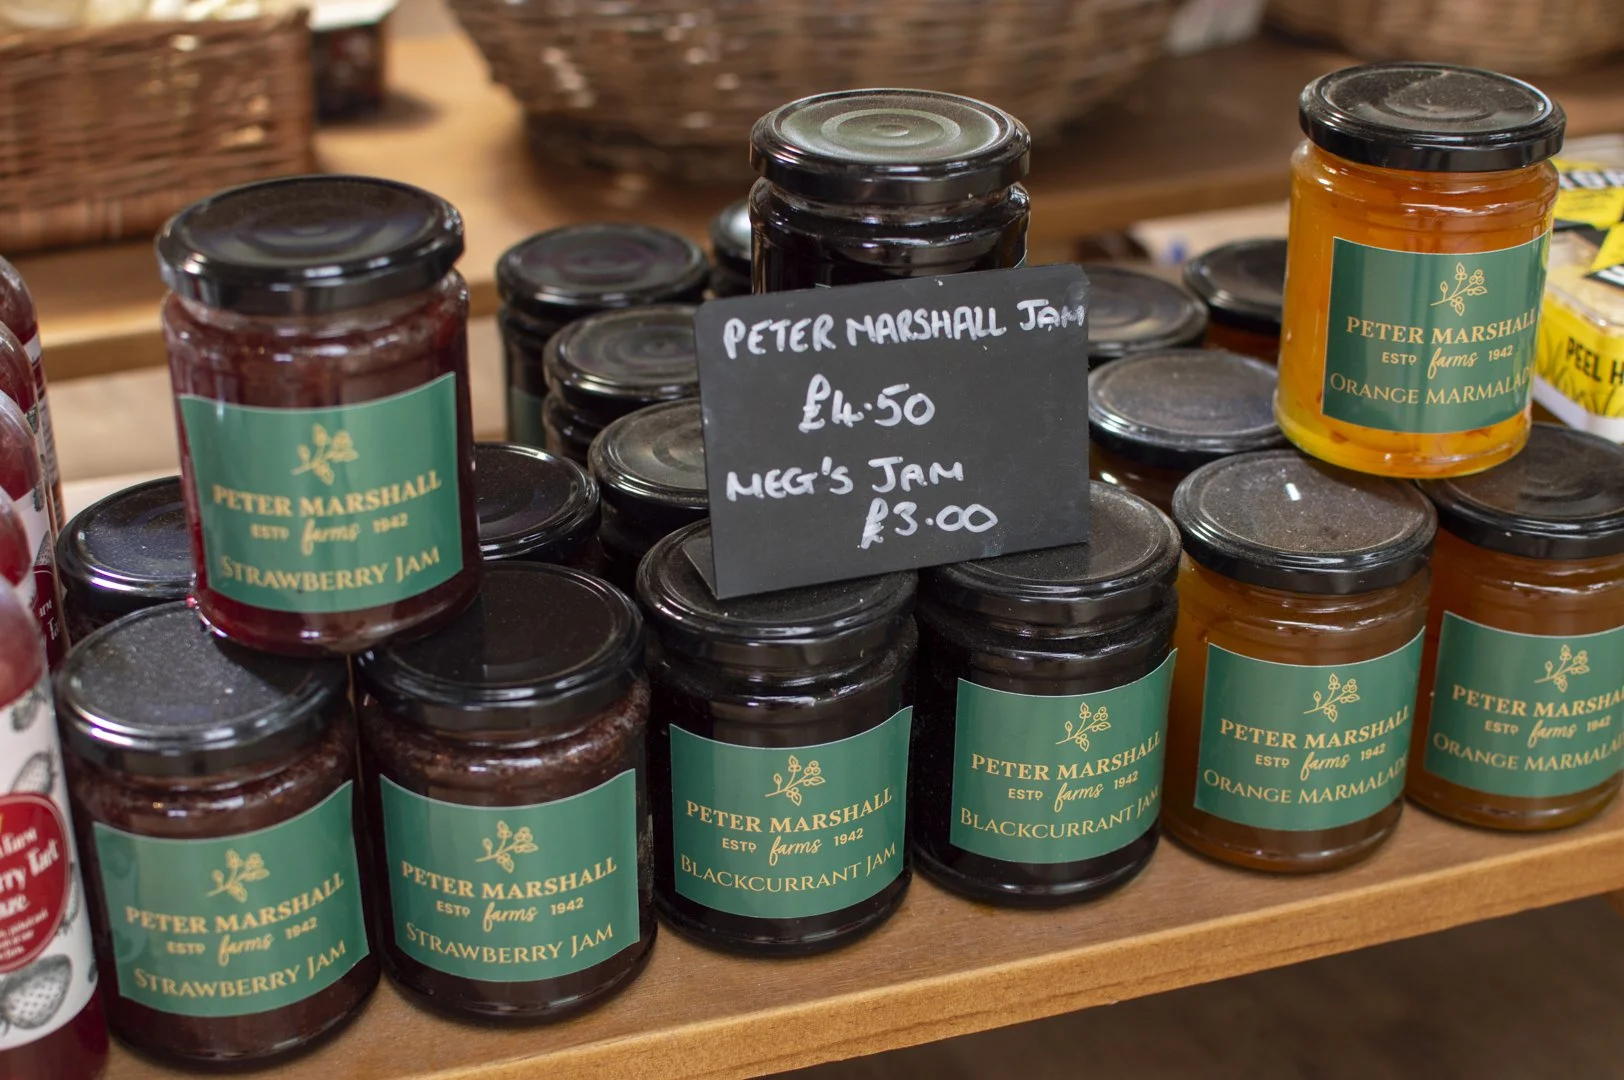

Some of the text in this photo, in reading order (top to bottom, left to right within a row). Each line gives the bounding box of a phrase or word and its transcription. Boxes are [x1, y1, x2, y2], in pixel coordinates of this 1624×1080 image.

[723, 299, 1085, 360] PETER MARSHALL JAM
[1346, 308, 1536, 344] PETER MARSHALL
[1381, 345, 1514, 380] ESTD farms 1942
[1566, 336, 1602, 383] PEEL
[799, 374, 935, 432] £4.50
[1330, 366, 1531, 405] ORANGE MARMALAD
[213, 470, 442, 518] PETER MARSHALL
[726, 456, 964, 501] MEG'S JAM
[252, 513, 408, 557] ESTD farms 1942
[860, 498, 998, 549] £3.00
[220, 546, 440, 592] STRAWBERRY JAM
[1453, 684, 1527, 717] PETER
[1220, 705, 1409, 749] PETER MARSHALL
[1527, 719, 1577, 749] farms
[971, 731, 1161, 781] PETER MARSHALL
[1255, 743, 1386, 781] ESTD farms 1942
[1433, 732, 1519, 770] ORANGE
[1008, 771, 1139, 813] ESTD farms 1942
[1204, 769, 1292, 804] ORANGE
[686, 787, 892, 833] PETER MARSHALL
[960, 784, 1159, 839] BLACKCURRANT JAM
[681, 842, 896, 893] BLACKCURRANT JAM
[722, 828, 864, 866] ESTD farms 1942
[402, 857, 617, 900] PETER MARSHALL
[125, 872, 344, 934] PETER MARSHALL
[436, 897, 584, 933] ESTD farms 1942
[166, 917, 318, 967] ESTD farms 1942
[405, 922, 614, 964] STRAWBERRY JAM
[134, 940, 346, 998] STRAWBERRY JAM
